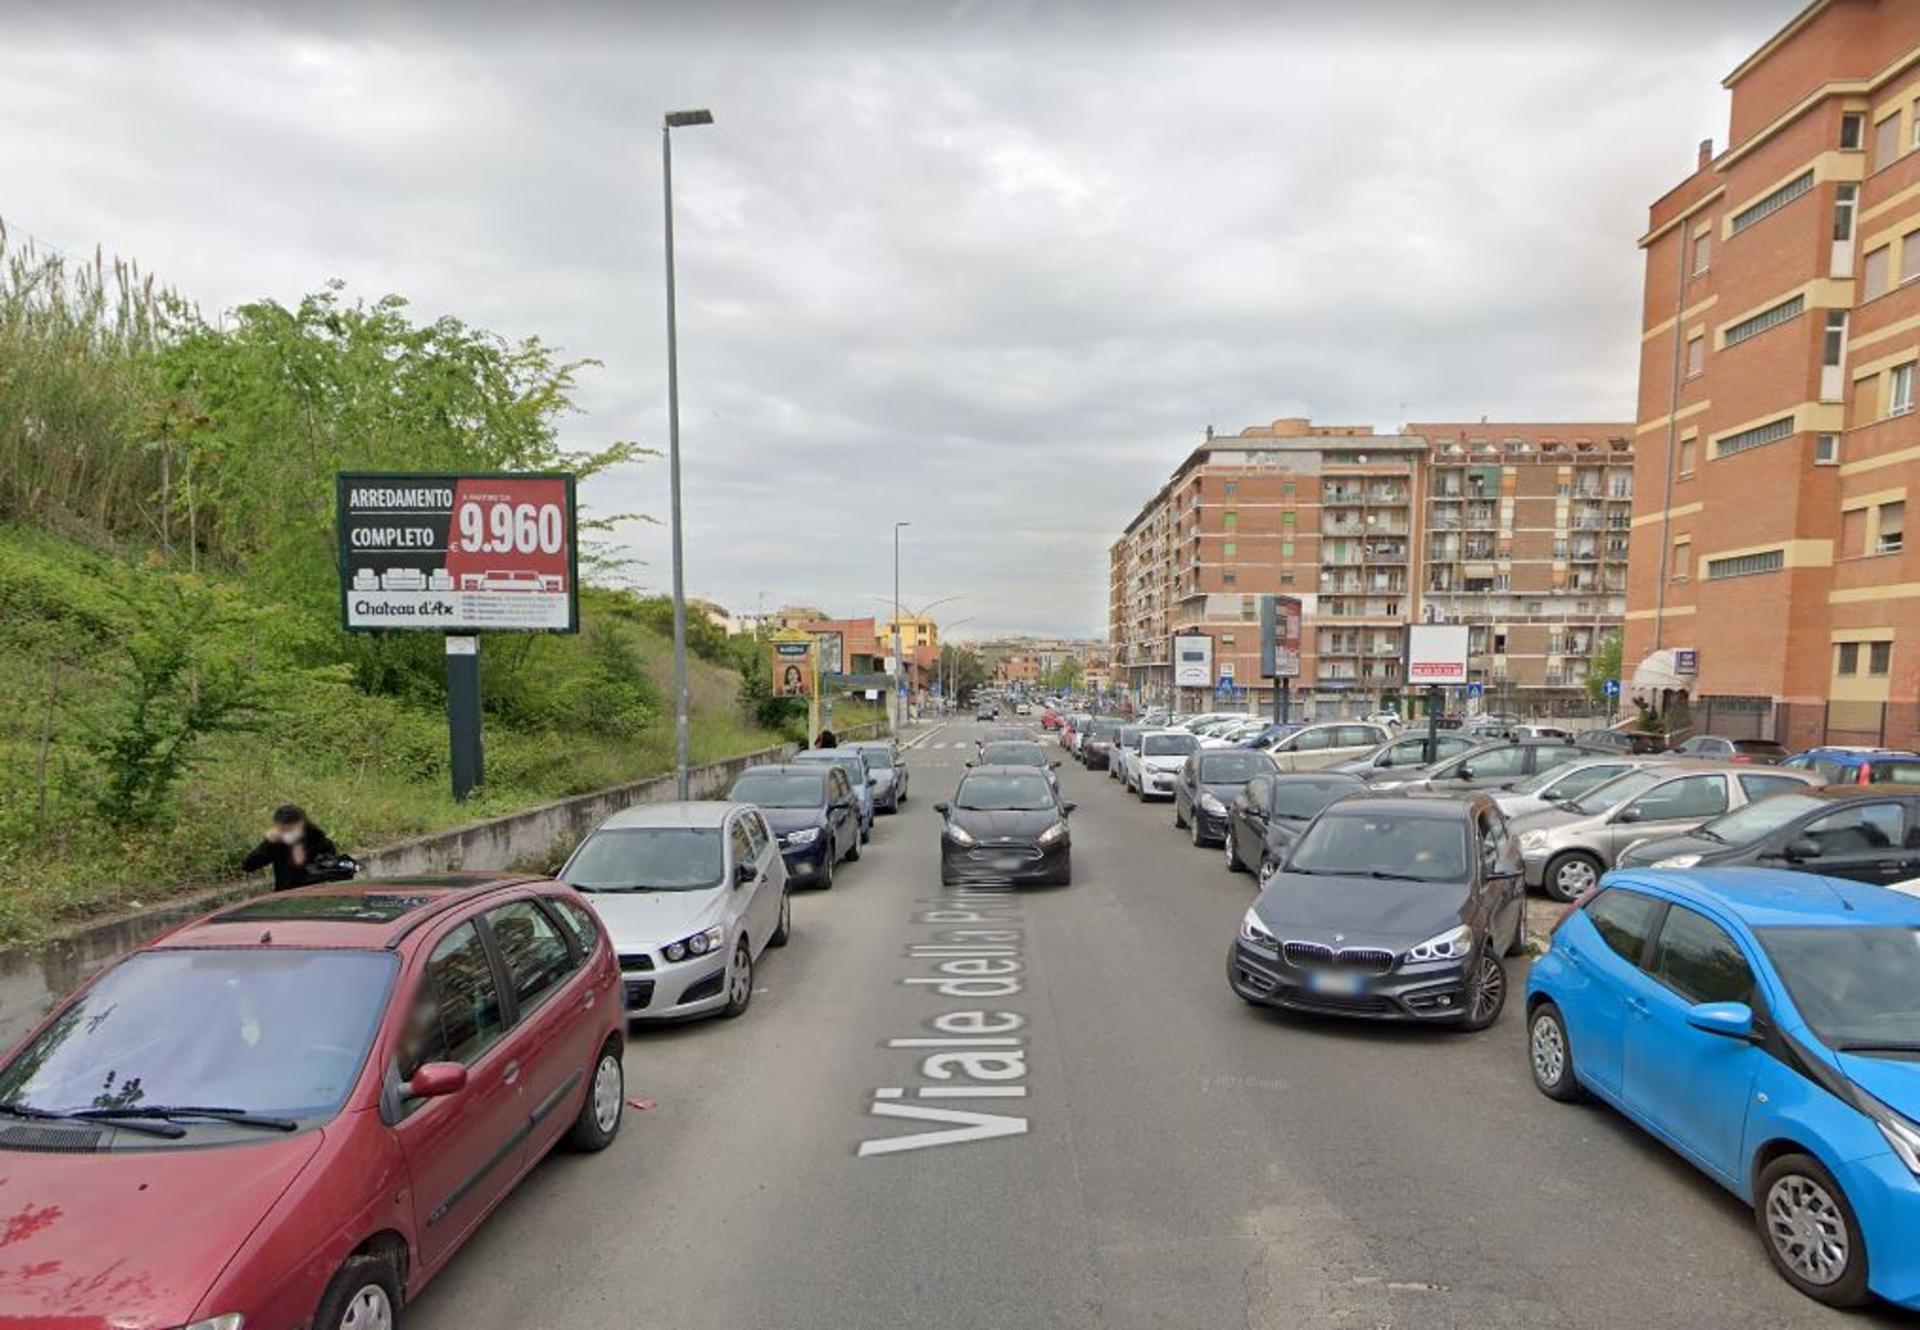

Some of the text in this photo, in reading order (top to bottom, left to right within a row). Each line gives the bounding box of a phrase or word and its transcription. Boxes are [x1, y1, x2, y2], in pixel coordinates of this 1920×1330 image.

[350, 489, 453, 507] ARREDAMENTO
[351, 528, 434, 546] COMPLETO
[459, 502, 562, 554] 9.960
[355, 600, 416, 616] Chateau
[419, 600, 454, 616] d'Ax
